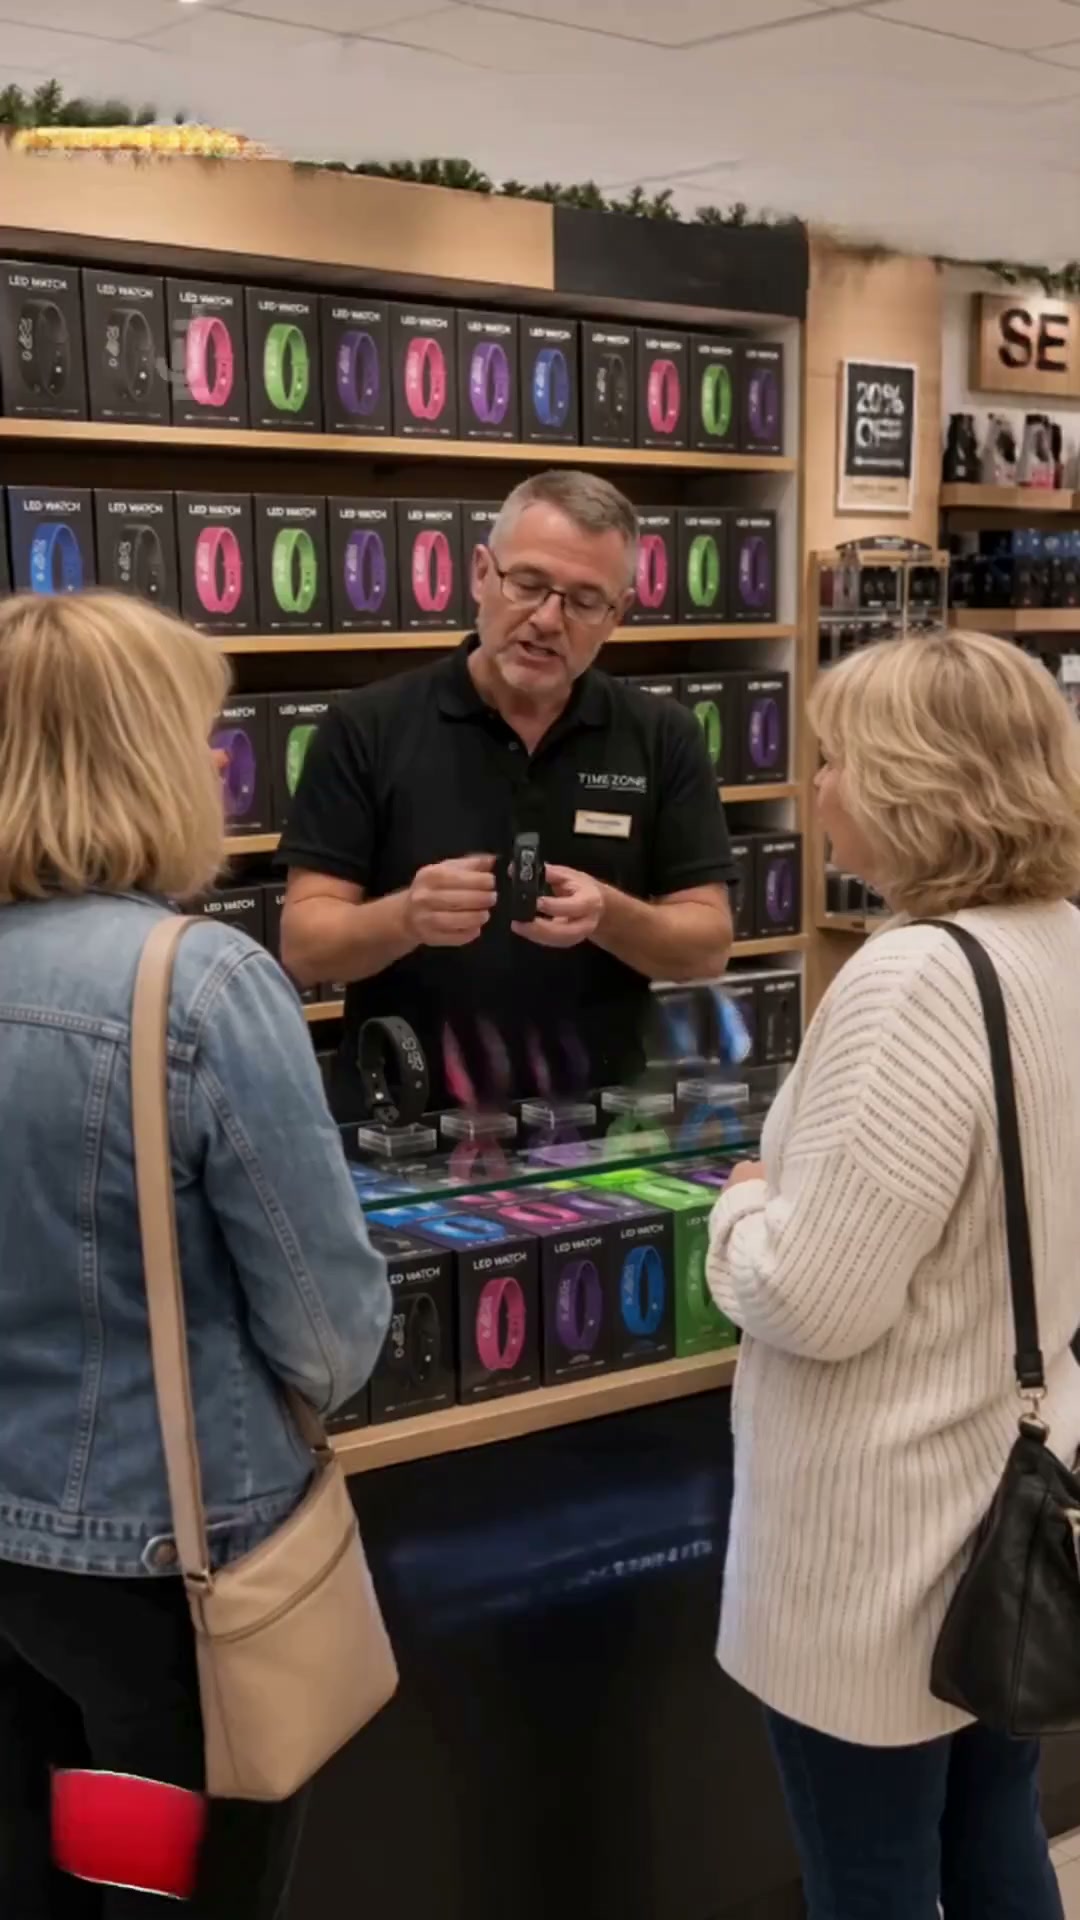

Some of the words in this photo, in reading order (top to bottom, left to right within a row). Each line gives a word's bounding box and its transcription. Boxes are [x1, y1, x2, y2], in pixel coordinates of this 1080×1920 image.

[998, 309, 1069, 371] SE
[856, 382, 904, 415] 20%
[620, 1228, 638, 1239] LED
[639, 1223, 664, 1236] WATCH
[554, 1242, 573, 1254] LED
[574, 1237, 602, 1251] WATCH
[473, 1258, 493, 1270] LED
[494, 1252, 526, 1267] WATCH
[406, 1267, 441, 1282] WATCH
